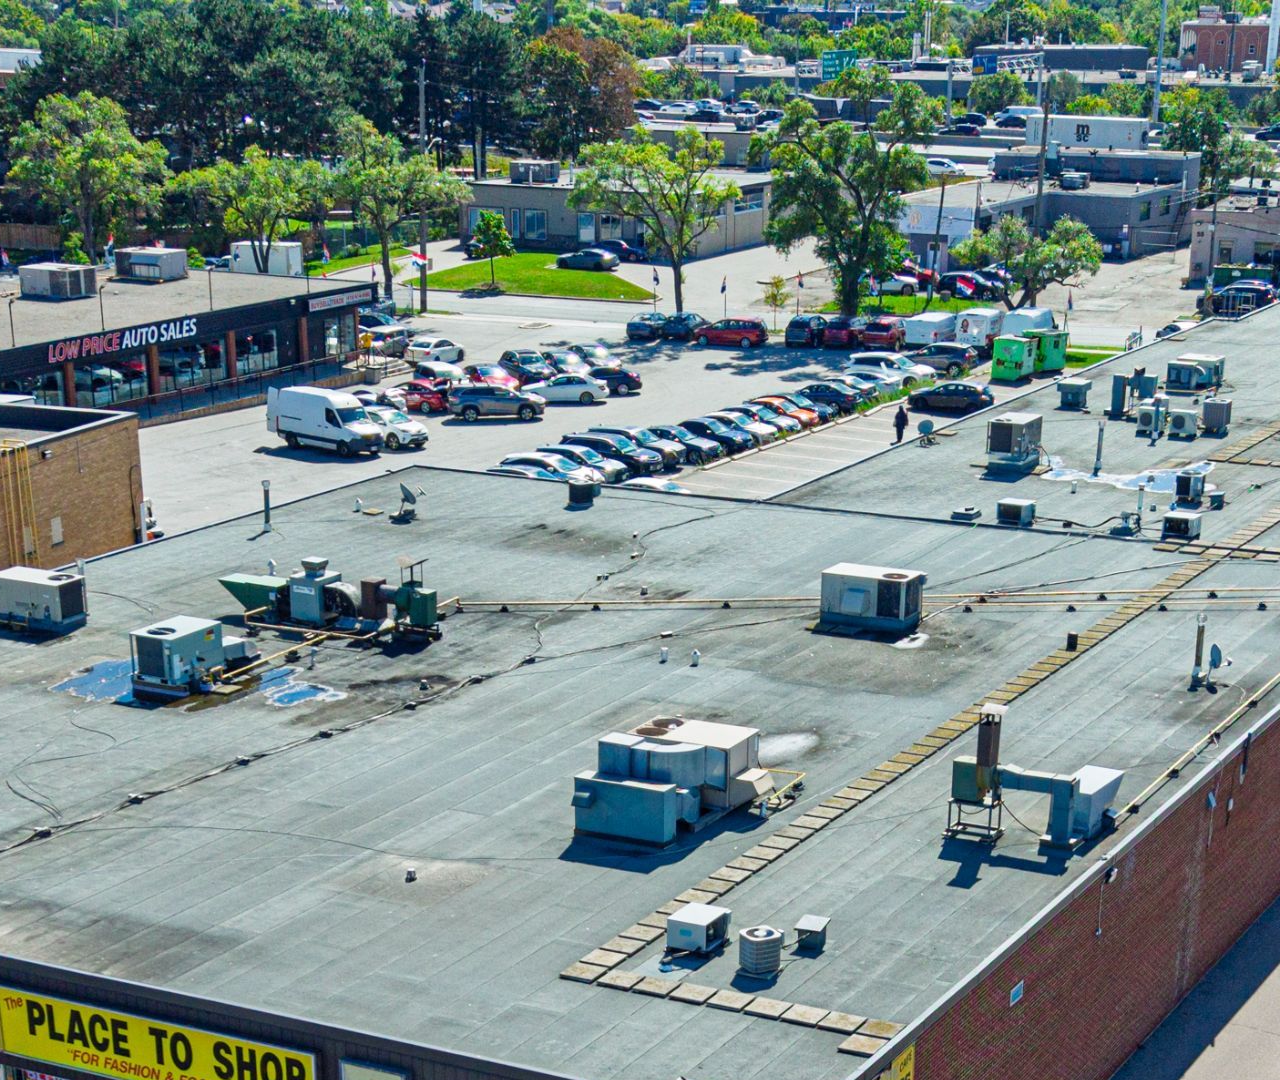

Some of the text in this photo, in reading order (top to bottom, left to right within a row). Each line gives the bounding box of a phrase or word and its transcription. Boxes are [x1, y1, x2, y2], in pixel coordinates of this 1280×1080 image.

[48, 318, 197, 364] LOW PRICE AUTO SALES
[4, 996, 23, 1011] The
[25, 999, 131, 1058] PLACE
[148, 1026, 193, 1071] TO
